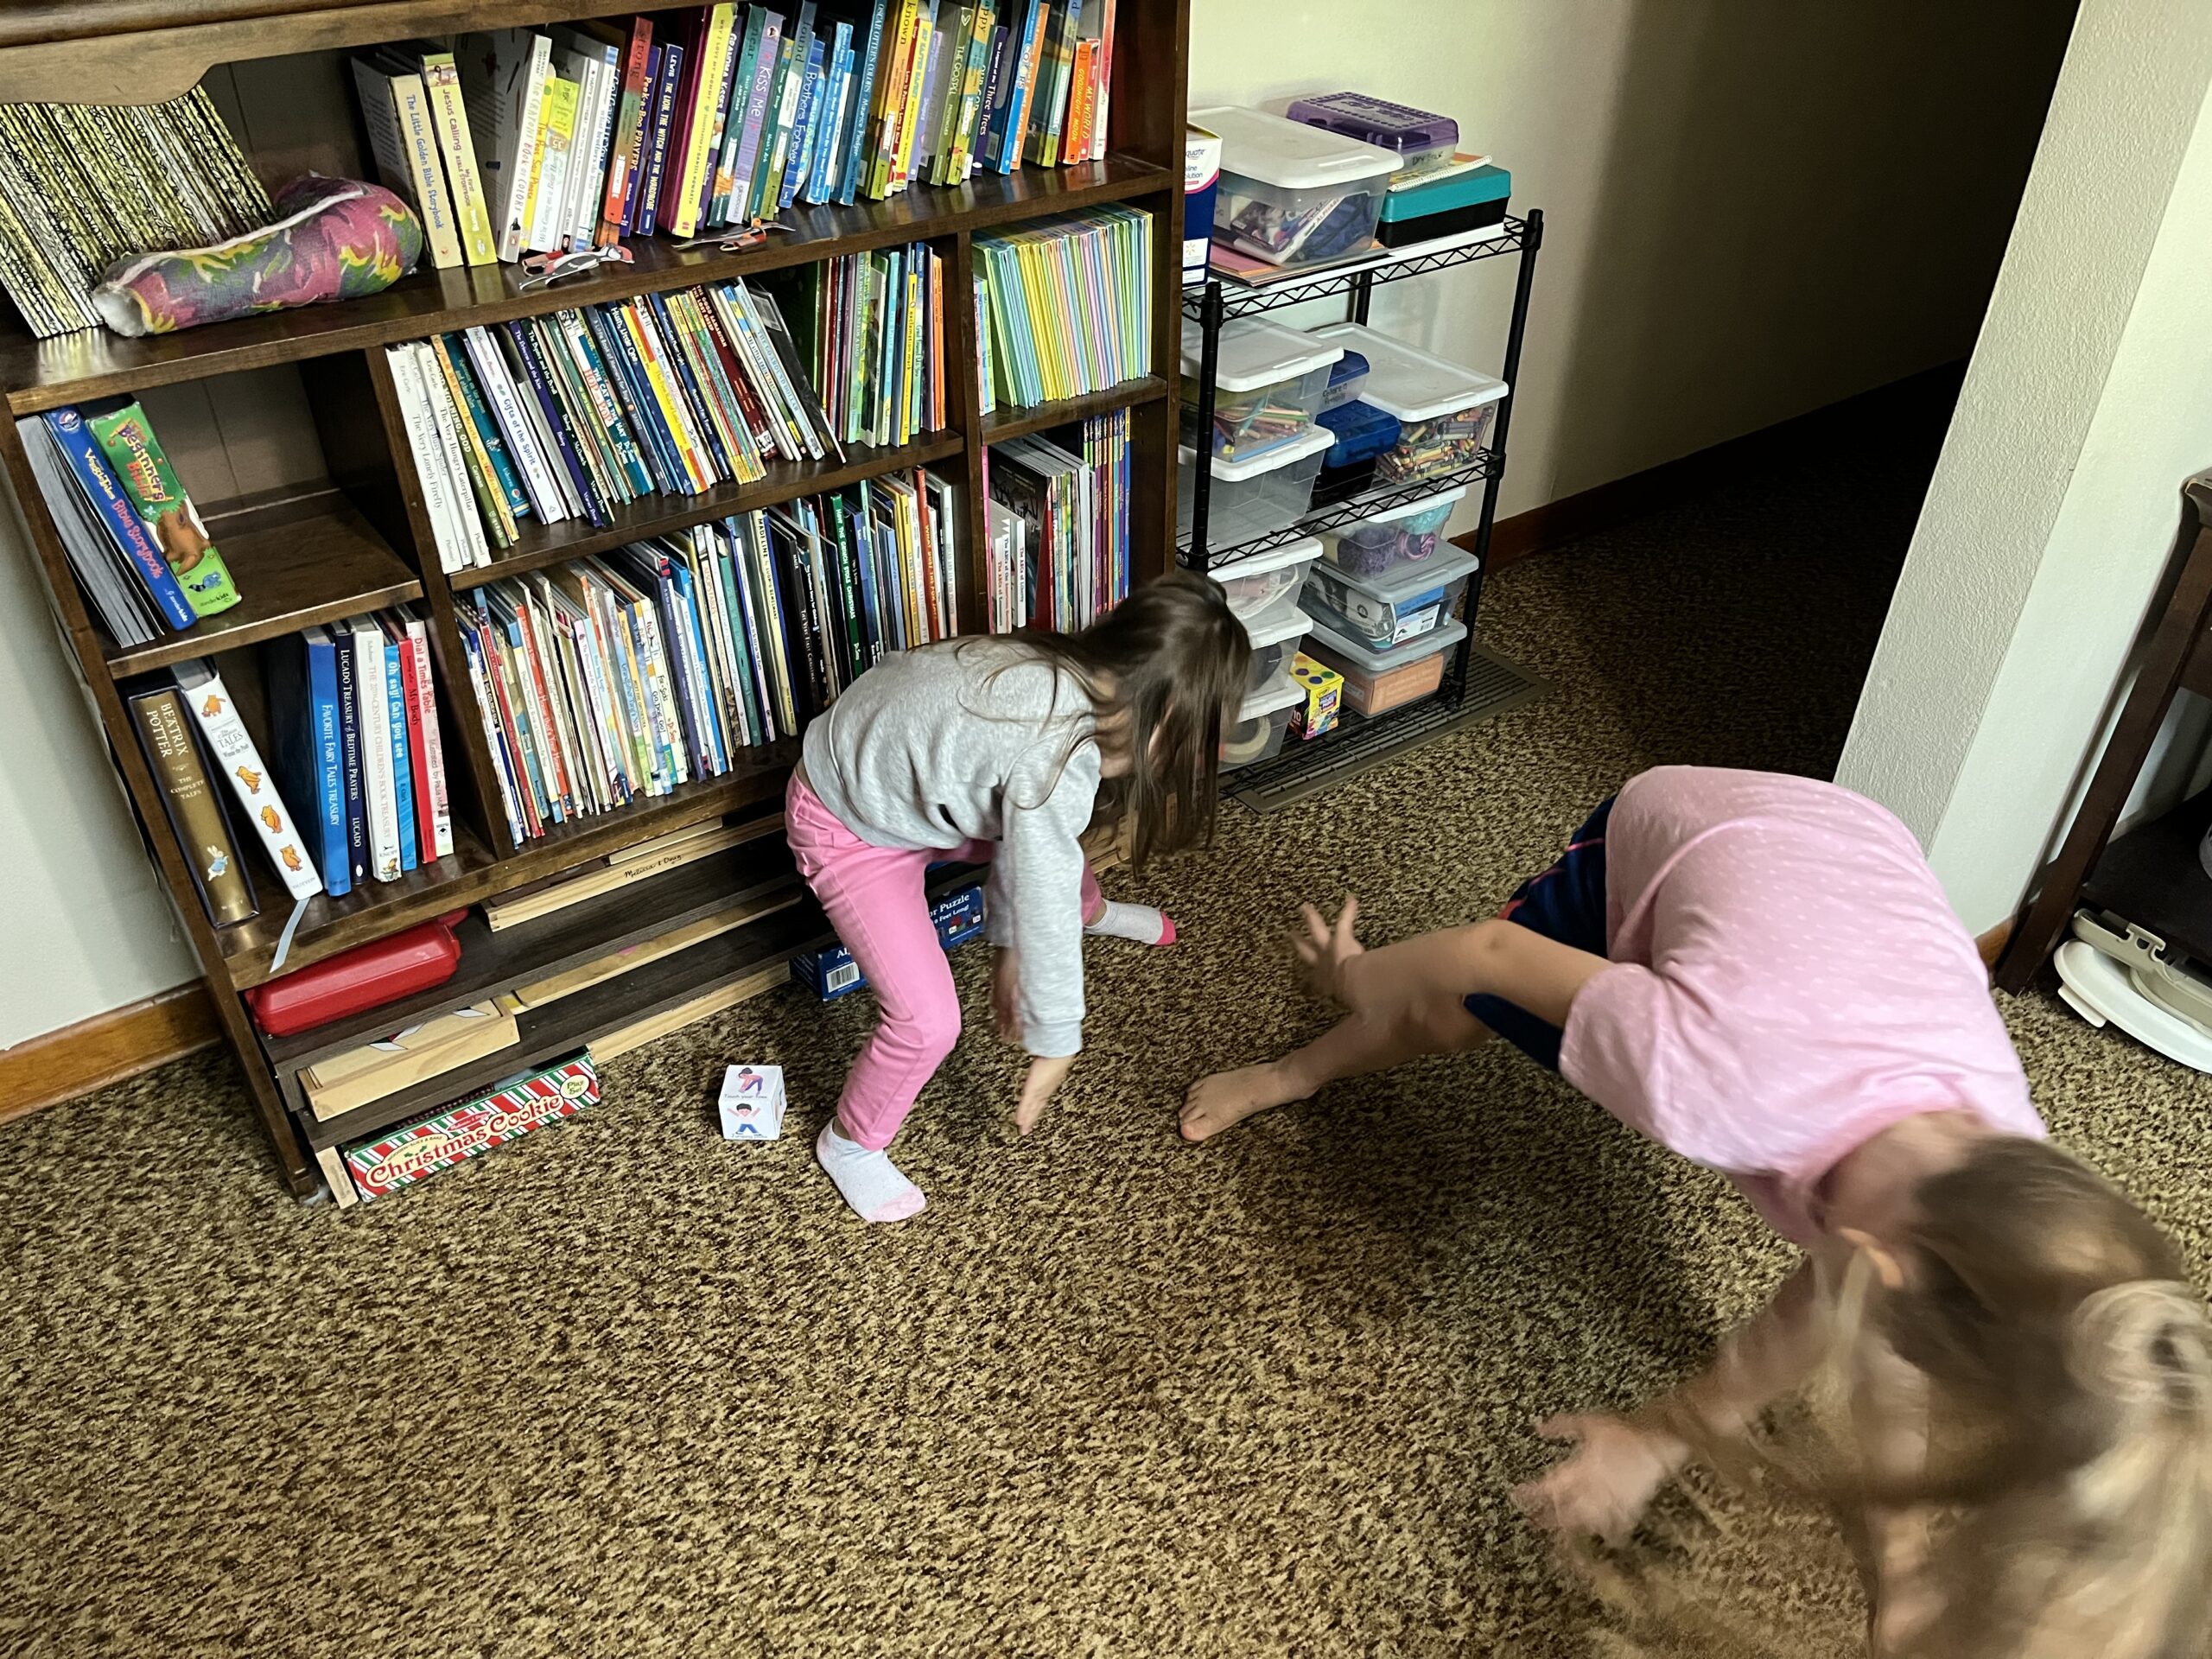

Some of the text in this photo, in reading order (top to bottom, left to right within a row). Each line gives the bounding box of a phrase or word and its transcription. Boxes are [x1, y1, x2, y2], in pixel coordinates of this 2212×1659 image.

[874, 3, 884, 29] OSCAR
[899, 1, 916, 45] known
[629, 30, 649, 79] strong
[747, 26, 760, 59] near
[794, 20, 811, 62] found
[667, 54, 677, 77] LEWIS
[863, 64, 874, 92] COLORS
[664, 81, 673, 93] THE
[798, 71, 817, 121] Brothers
[983, 85, 996, 110] Three
[1074, 68, 1084, 114] GOODNIGHT
[442, 88, 461, 150] Jesus Calling
[658, 113, 668, 126] THE
[750, 97, 764, 117] Me
[857, 98, 868, 128] Maurice
[979, 113, 991, 135] Trees
[629, 130, 643, 170] PRAYERS
[655, 127, 665, 149] WITCH
[788, 124, 806, 165] Forever
[405, 94, 444, 229] The Little Golden Bible Storybook
[652, 163, 660, 175] THE
[653, 149, 662, 162] AND
[645, 175, 658, 210] WARDROBE
[701, 296, 712, 314] GOOD
[610, 306, 638, 362] Hush, Little One
[582, 367, 600, 393] HOP
[595, 400, 613, 425] POP
[592, 366, 602, 382] THE
[598, 383, 610, 399] CAT
[607, 407, 619, 421] THE
[614, 422, 626, 437] HAT
[459, 433, 473, 454] GOD
[503, 397, 536, 465] Gifts of the Spirit
[411, 413, 442, 508] The Very Lonely Firefly
[438, 406, 472, 511] The Very Hungry Caterpillar
[111, 499, 134, 528] Bible
[126, 525, 162, 578] Storybook
[757, 518, 767, 557] MADELINE
[846, 585, 855, 619] CHRISTMAS
[414, 637, 424, 654] Dial
[340, 649, 350, 683] LUCADO
[368, 665, 378, 683] THE
[416, 664, 429, 690] Times
[342, 684, 353, 723] TREASURY
[386, 661, 404, 758] Oh say! Can you see
[407, 687, 421, 727] My Body
[422, 690, 432, 714] Table
[146, 709, 173, 757] POTTER
[160, 702, 188, 755] BEATRIX
[217, 730, 244, 748] TALES
[321, 704, 339, 825] FAVORITE FAIRY TALES TREASURY
[346, 733, 356, 766] BEDTIME
[348, 767, 358, 800] PRAYERS
[378, 779, 387, 800] BOOK
[352, 817, 361, 847] LUCADO
[380, 801, 391, 837] TREASURY
[939, 894, 969, 912] Puzzle
[567, 1079, 584, 1091] Play
[569, 1086, 583, 1095] Set
[370, 1095, 563, 1186] Christmas Cookie
